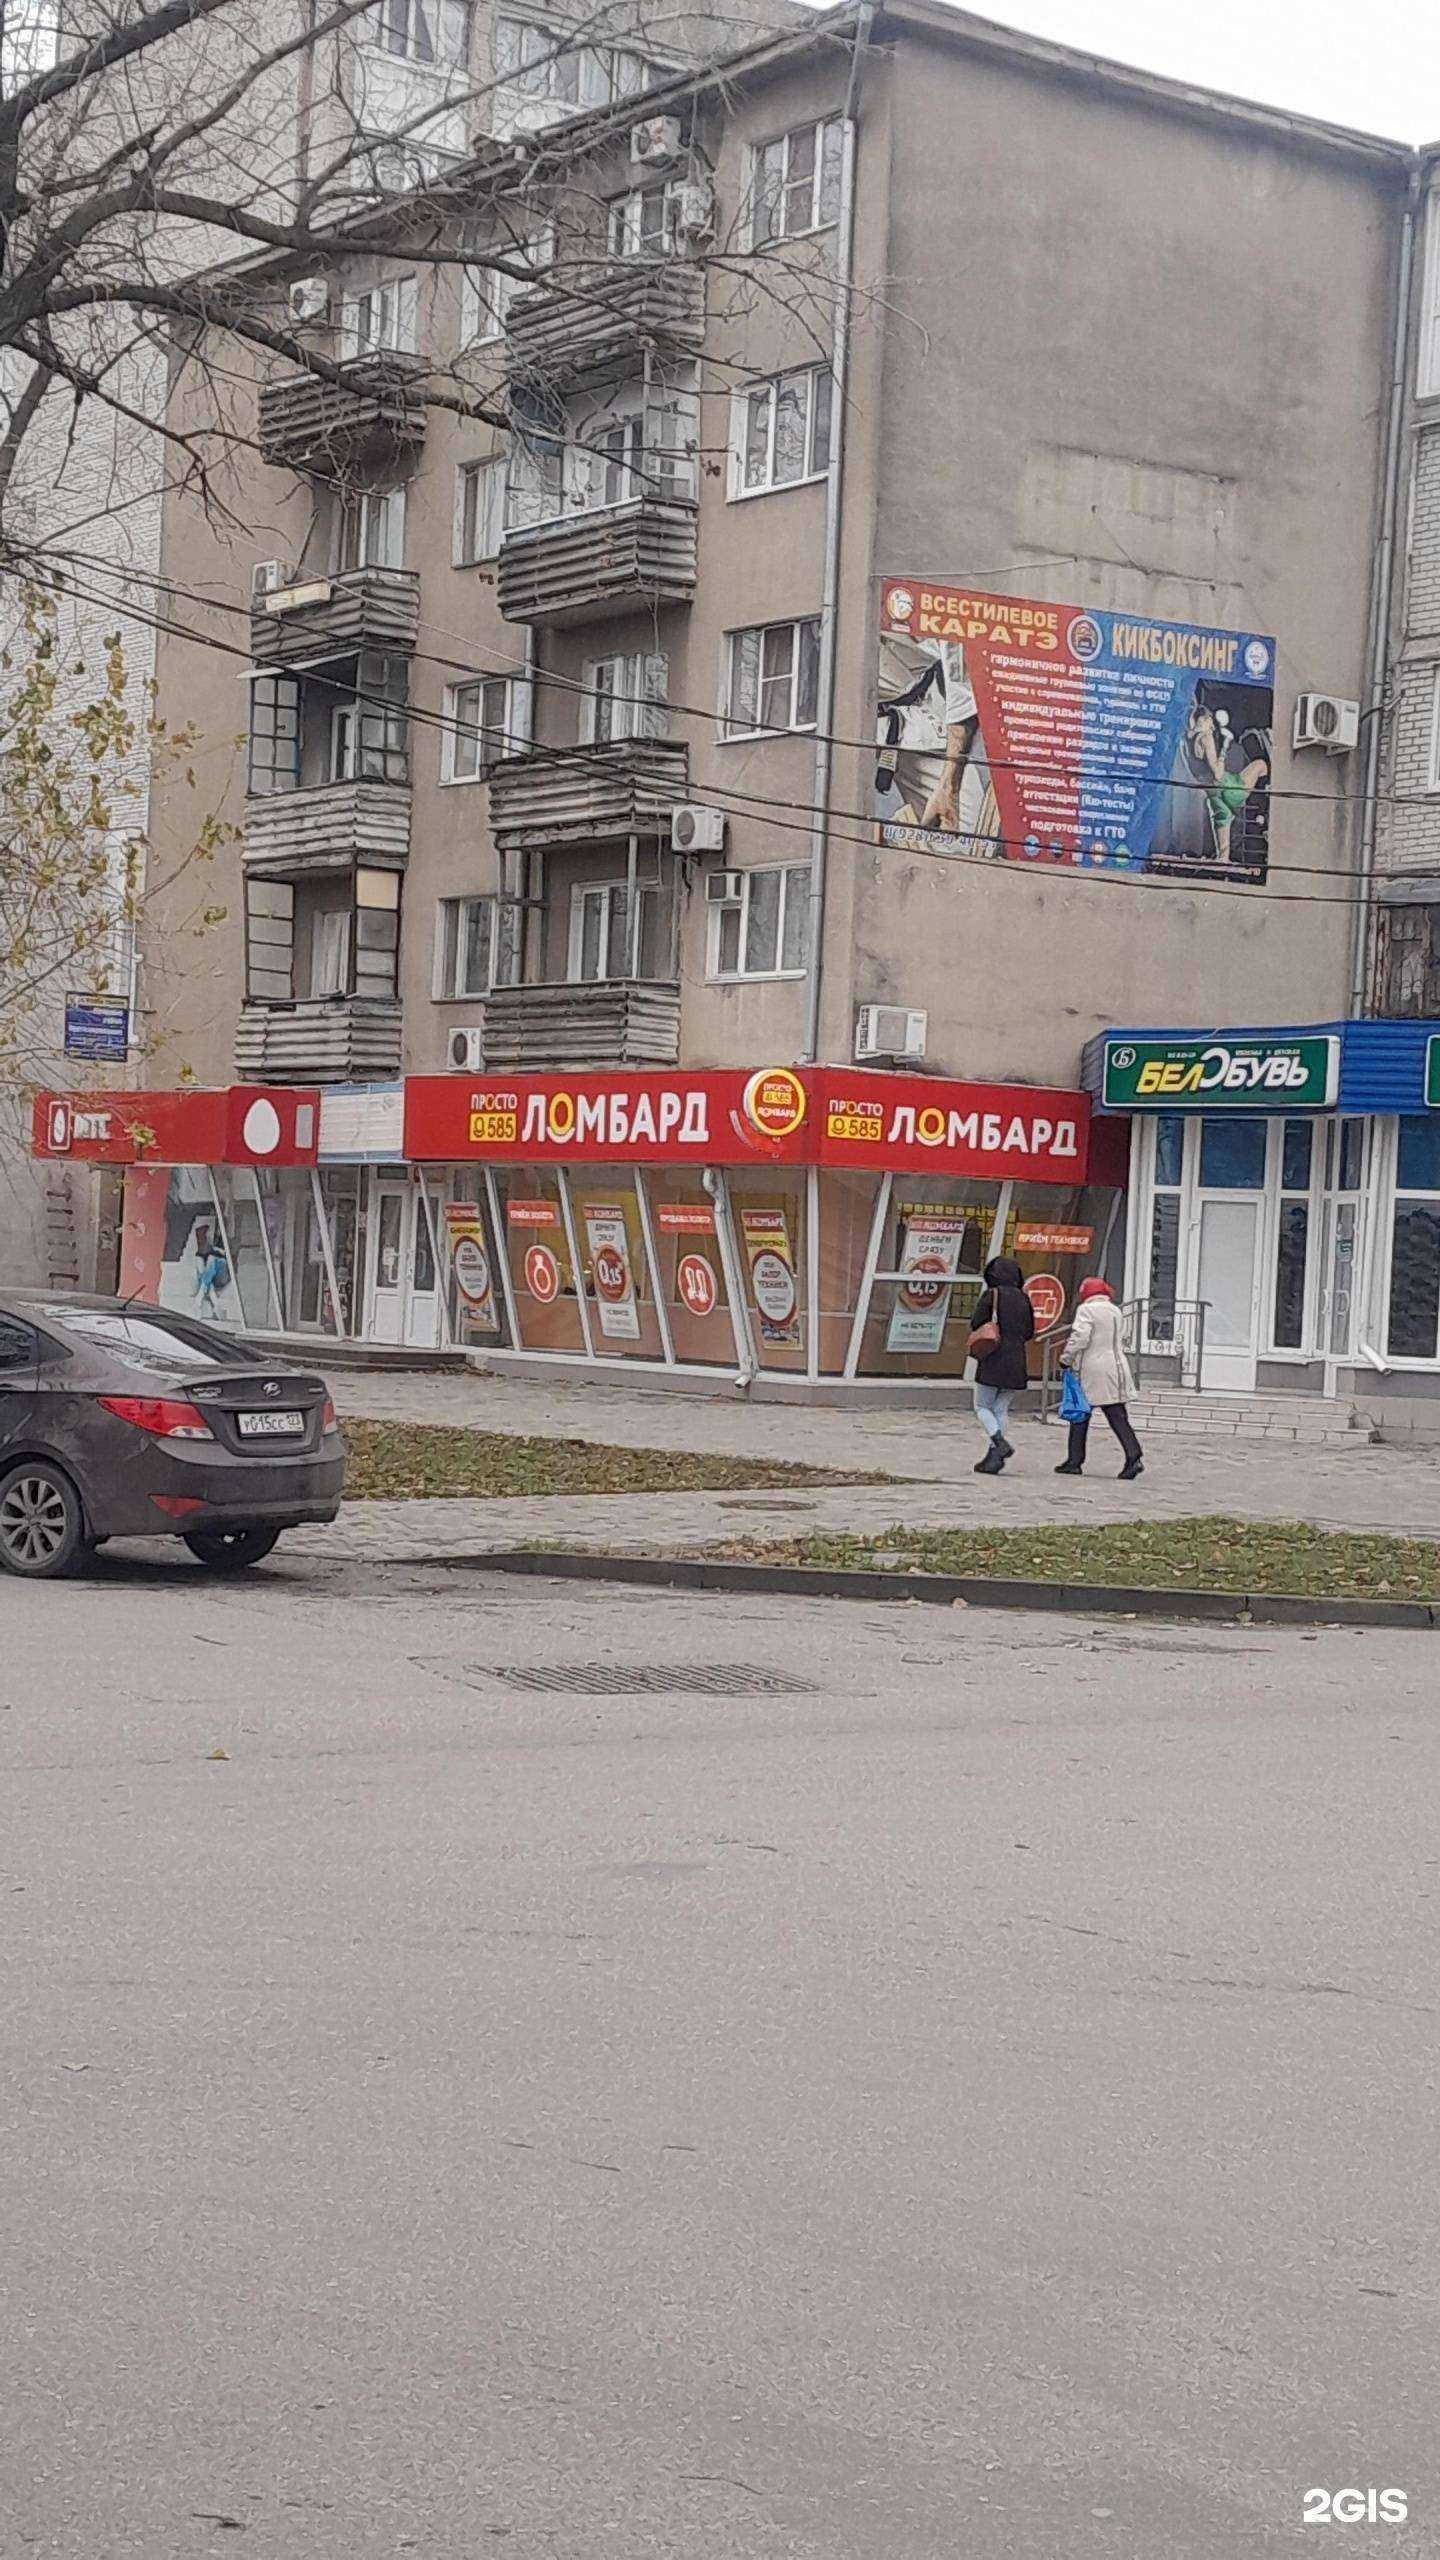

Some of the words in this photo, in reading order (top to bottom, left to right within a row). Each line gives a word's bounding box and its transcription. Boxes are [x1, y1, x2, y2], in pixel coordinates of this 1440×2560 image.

[920, 592, 1058, 630] ВСЕСТИЛЕВОЕ
[919, 613, 1058, 650] КАРАТЭ
[1111, 622, 1239, 672] КИКБОКСИНГ
[471, 1093, 517, 1111] ПРОСТО
[521, 1092, 709, 1143] ЛОМБАРД
[829, 1099, 883, 1117] ПРОСТО
[888, 1106, 1077, 1156] ЛОМБАРД
